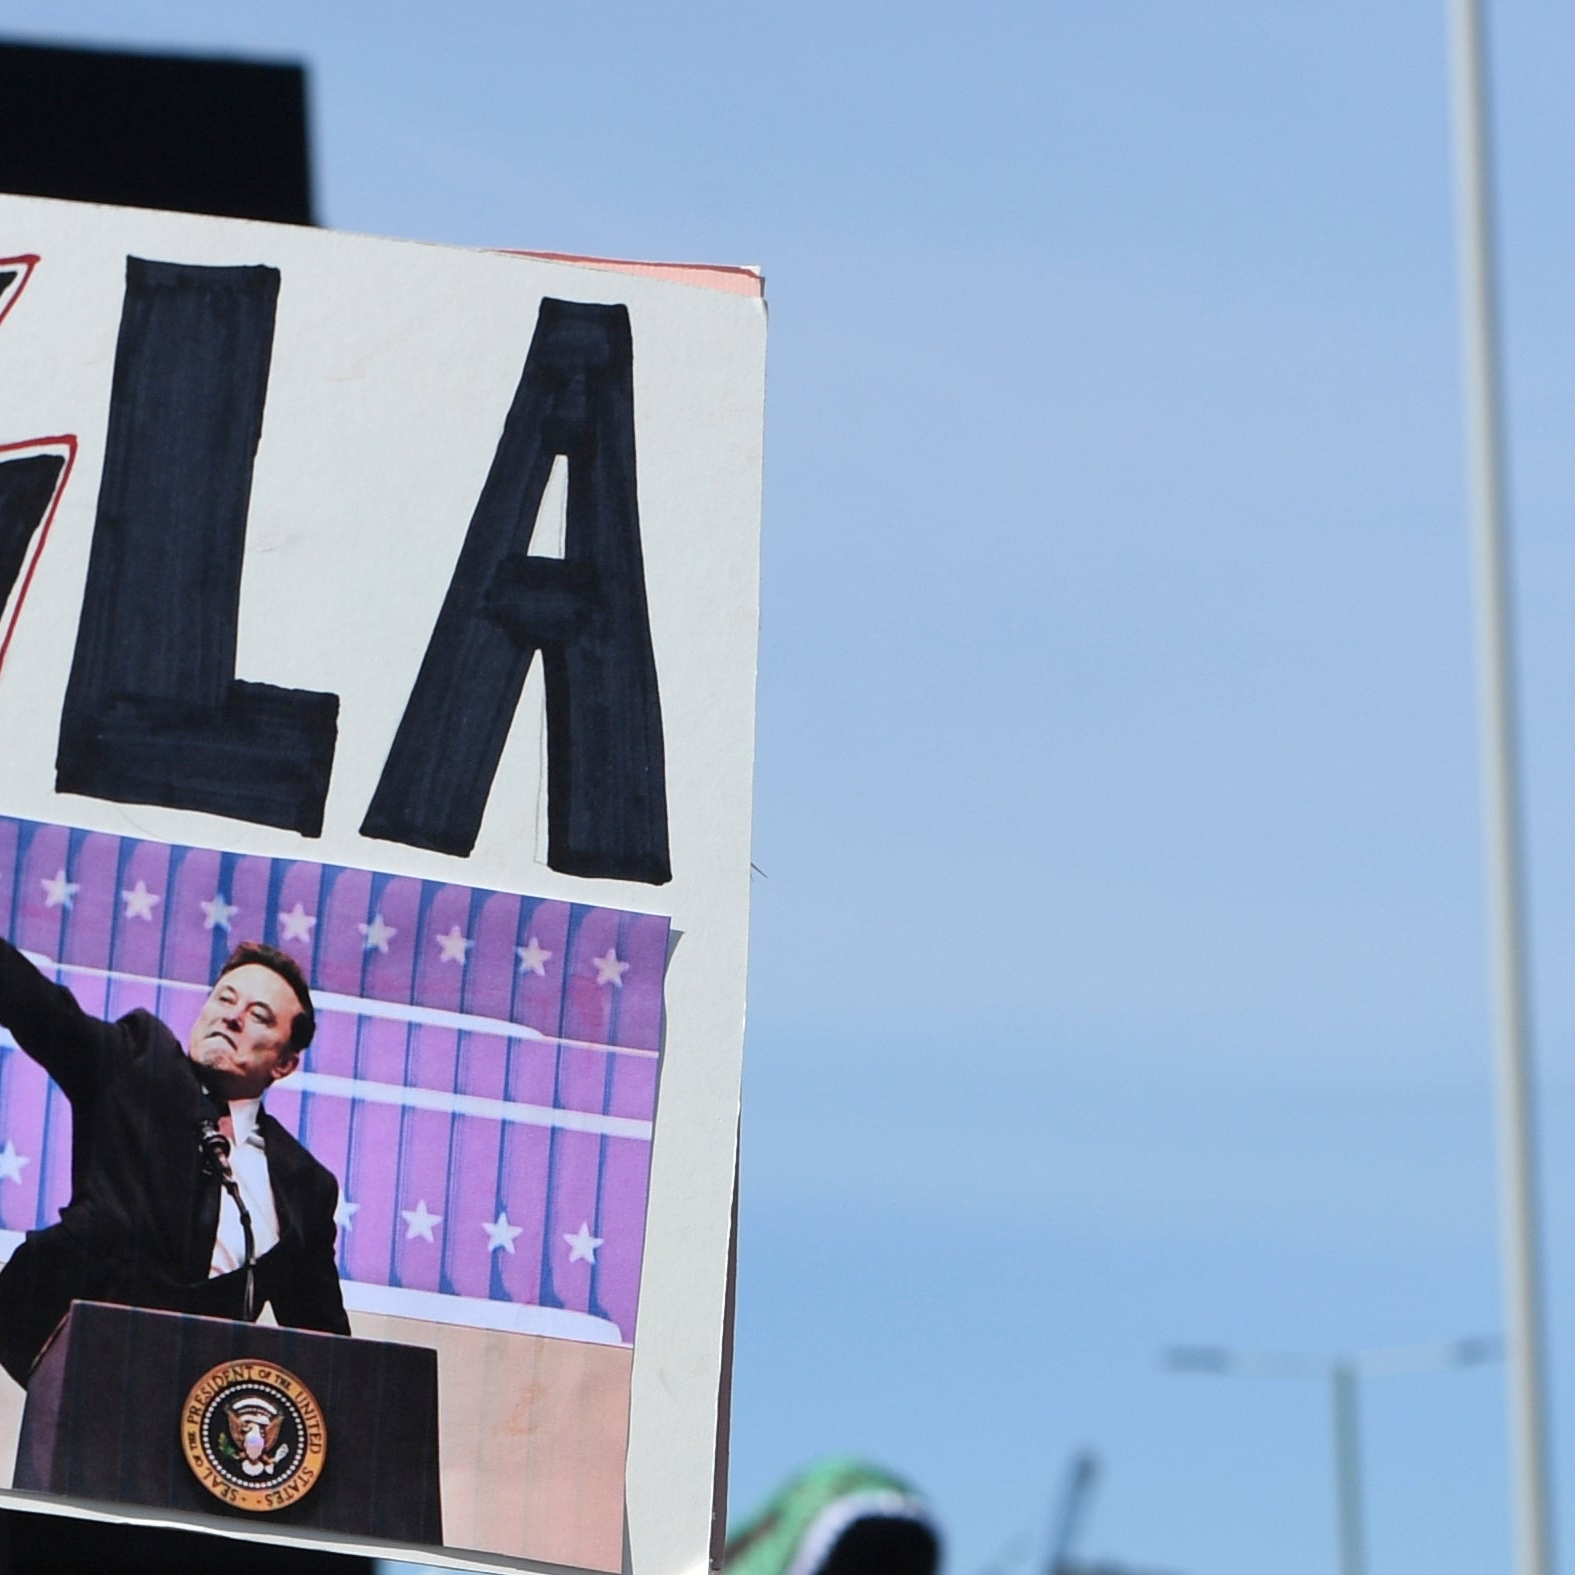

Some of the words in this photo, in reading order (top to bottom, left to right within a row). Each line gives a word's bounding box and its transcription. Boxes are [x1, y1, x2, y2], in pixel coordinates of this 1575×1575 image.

[258, 1368, 271, 1379] OF
[274, 1374, 293, 1390] THE
[188, 1366, 253, 1425] PRESIDENT
[295, 1391, 323, 1455] UNITED
[189, 1431, 199, 1450] THE
[203, 1468, 239, 1502] SEAL
[264, 1466, 314, 1507] STATES
